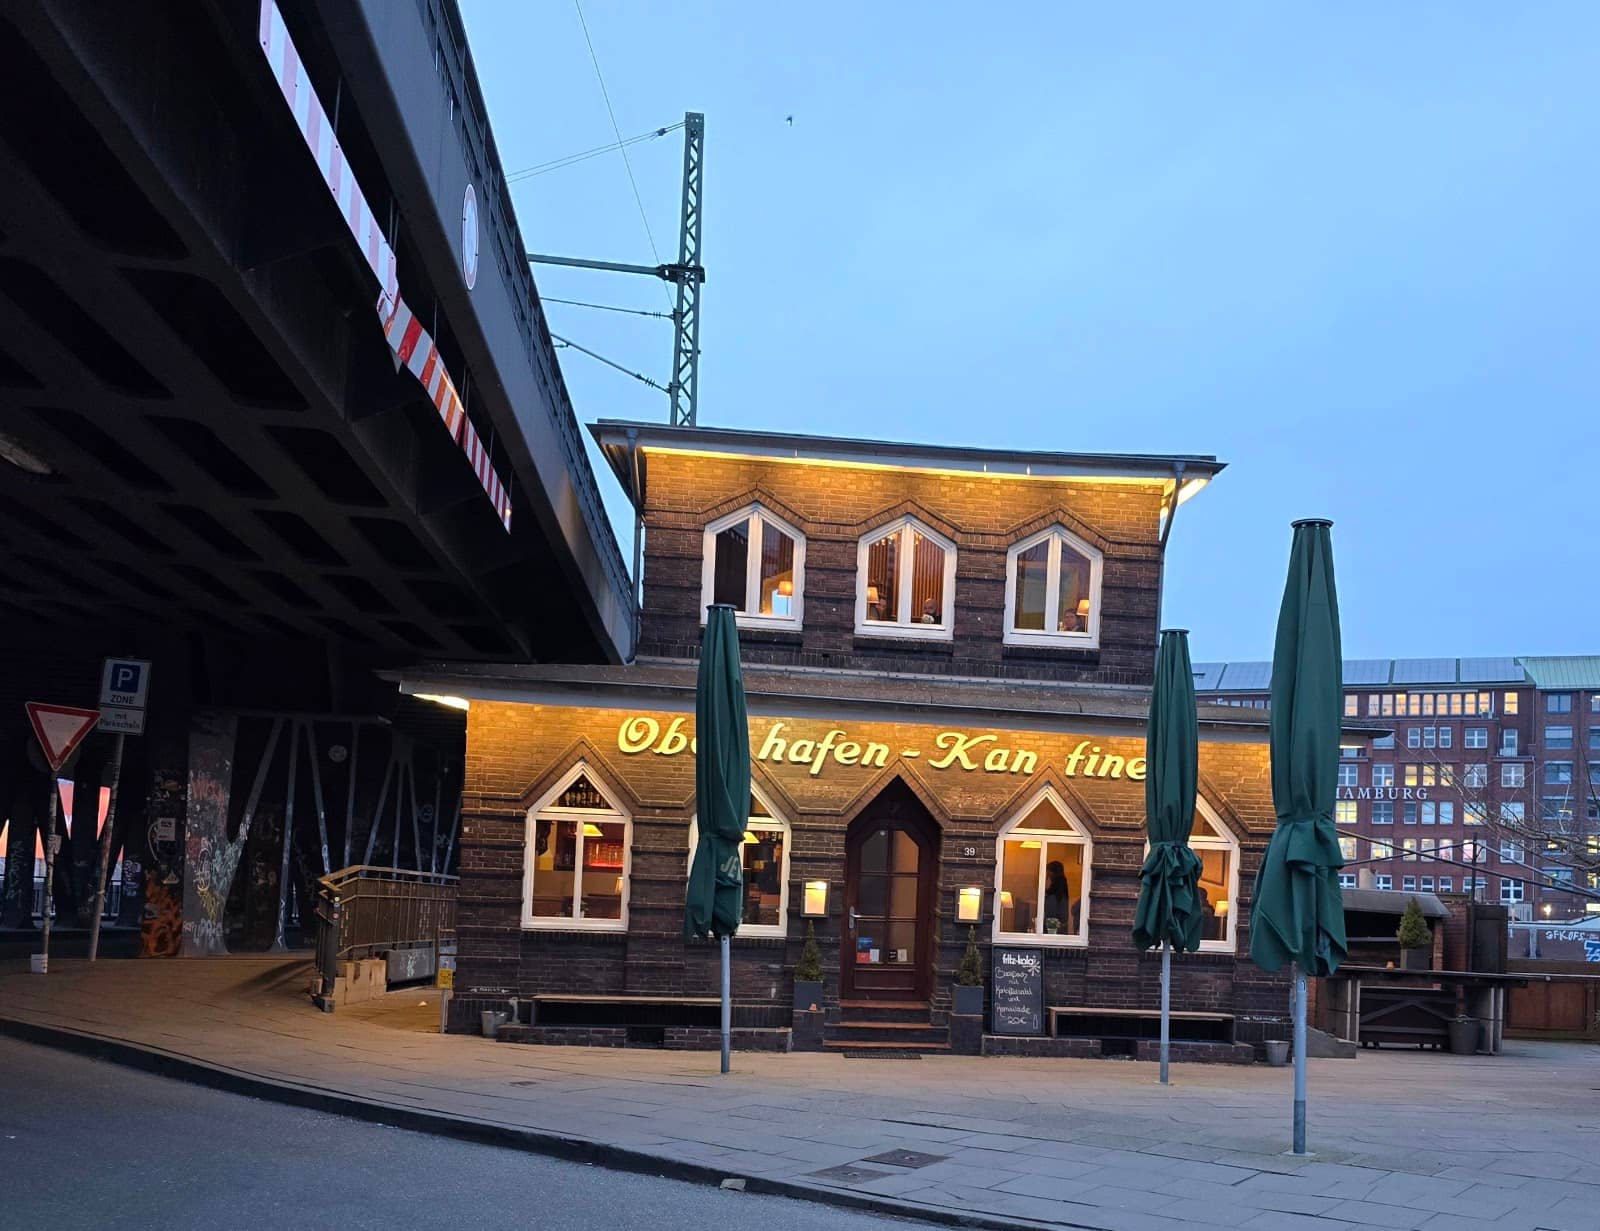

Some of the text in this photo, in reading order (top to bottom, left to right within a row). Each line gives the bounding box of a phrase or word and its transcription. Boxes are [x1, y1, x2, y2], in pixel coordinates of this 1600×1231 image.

[117, 667, 134, 688] P
[111, 694, 135, 705] ZONE
[114, 711, 127, 719] mit
[964, 847, 976, 856] 39
